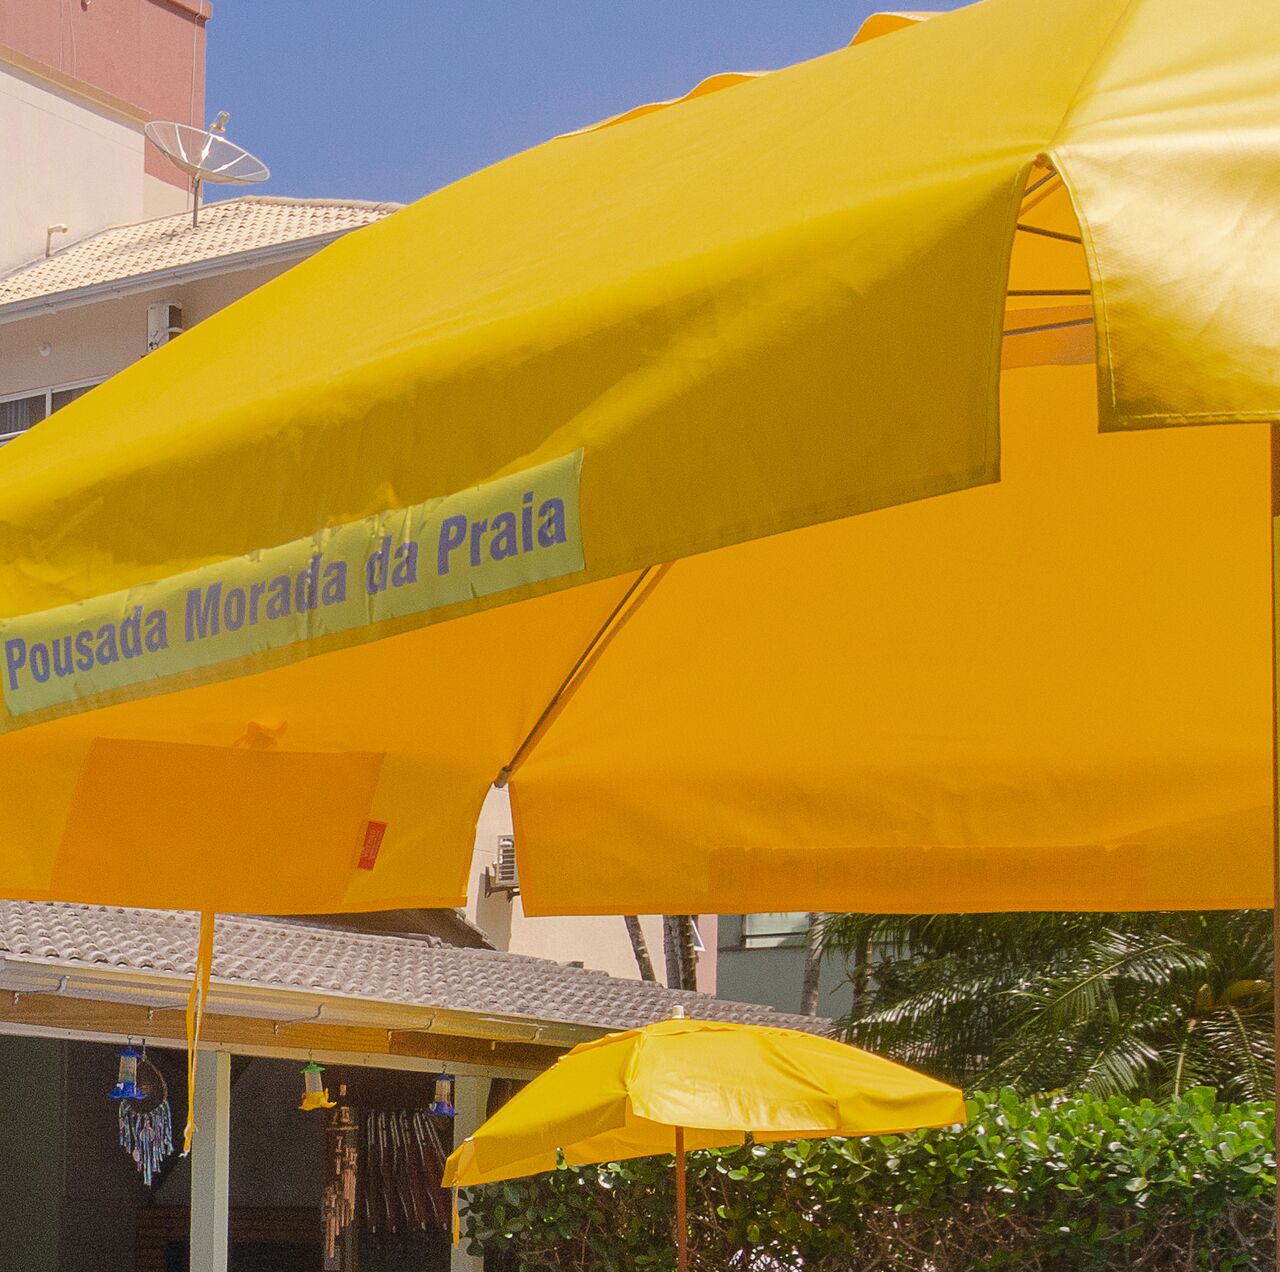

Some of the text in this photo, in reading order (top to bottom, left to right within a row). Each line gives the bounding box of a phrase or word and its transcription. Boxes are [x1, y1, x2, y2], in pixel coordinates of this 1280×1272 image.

[4, 491, 567, 691] Pousada Morada da Praia
